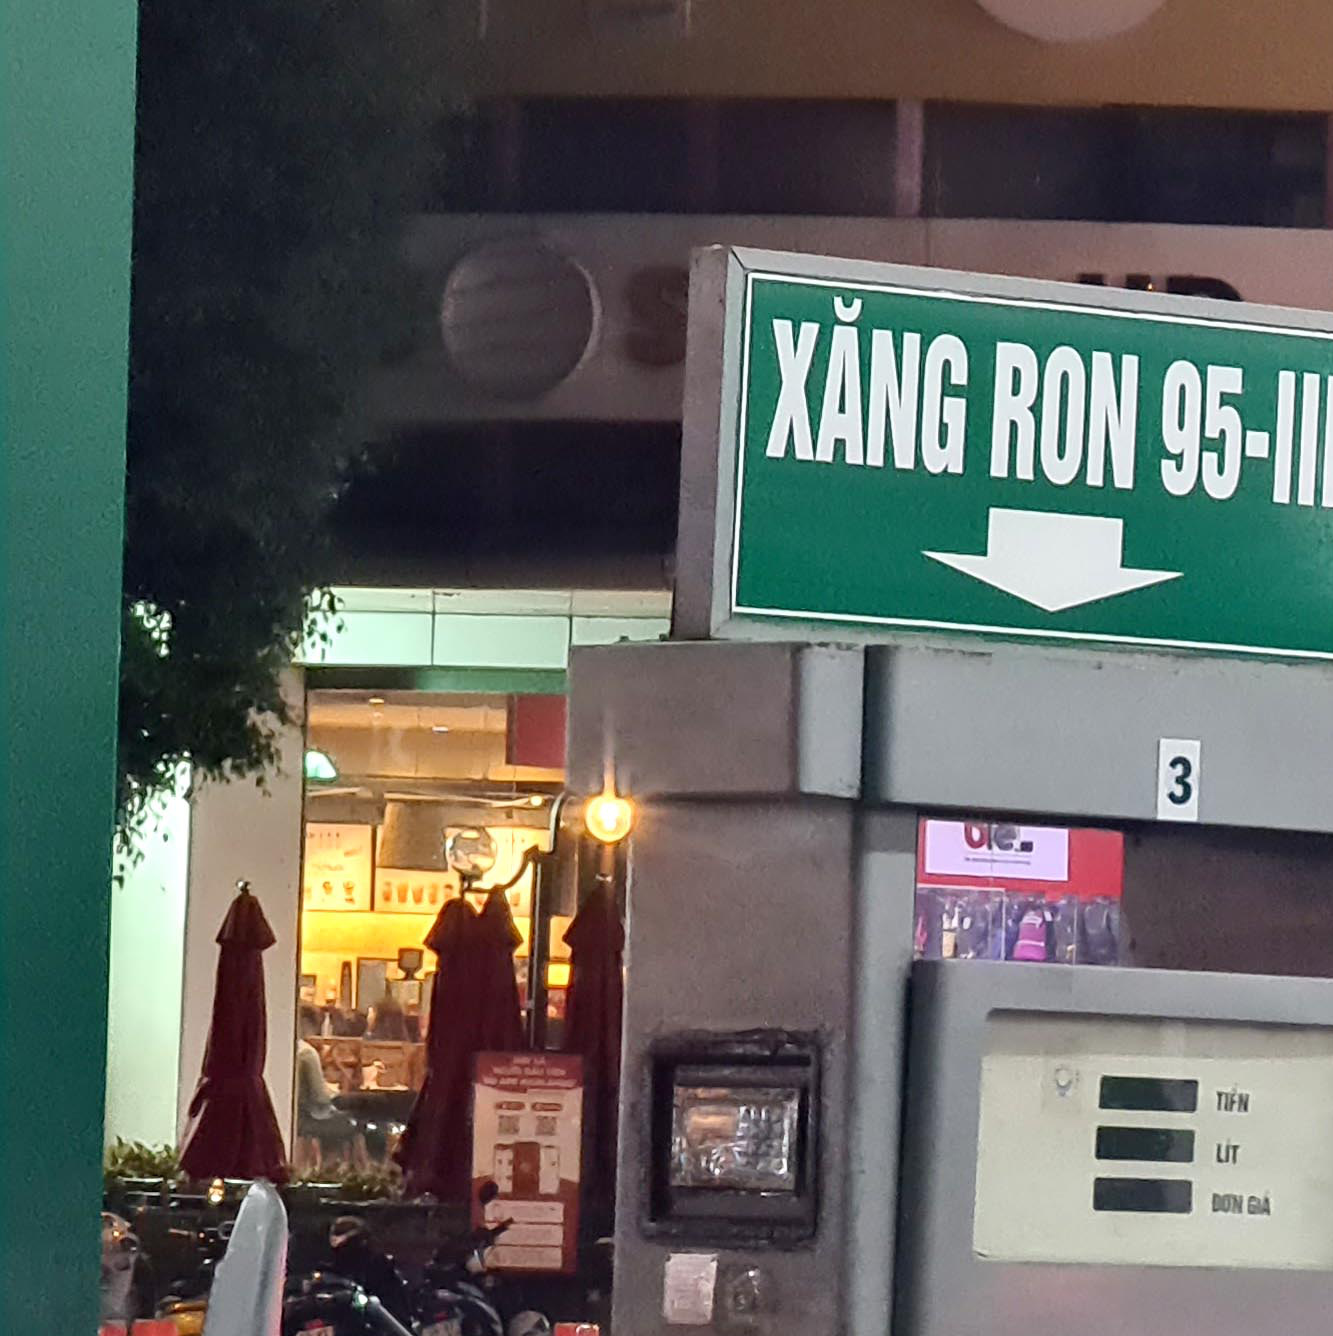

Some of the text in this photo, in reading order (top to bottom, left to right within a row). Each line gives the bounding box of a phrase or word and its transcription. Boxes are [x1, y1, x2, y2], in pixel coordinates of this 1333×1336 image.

[766, 296, 968, 474] XĂNG
[990, 341, 1139, 490] RON
[1168, 755, 1192, 805] 3
